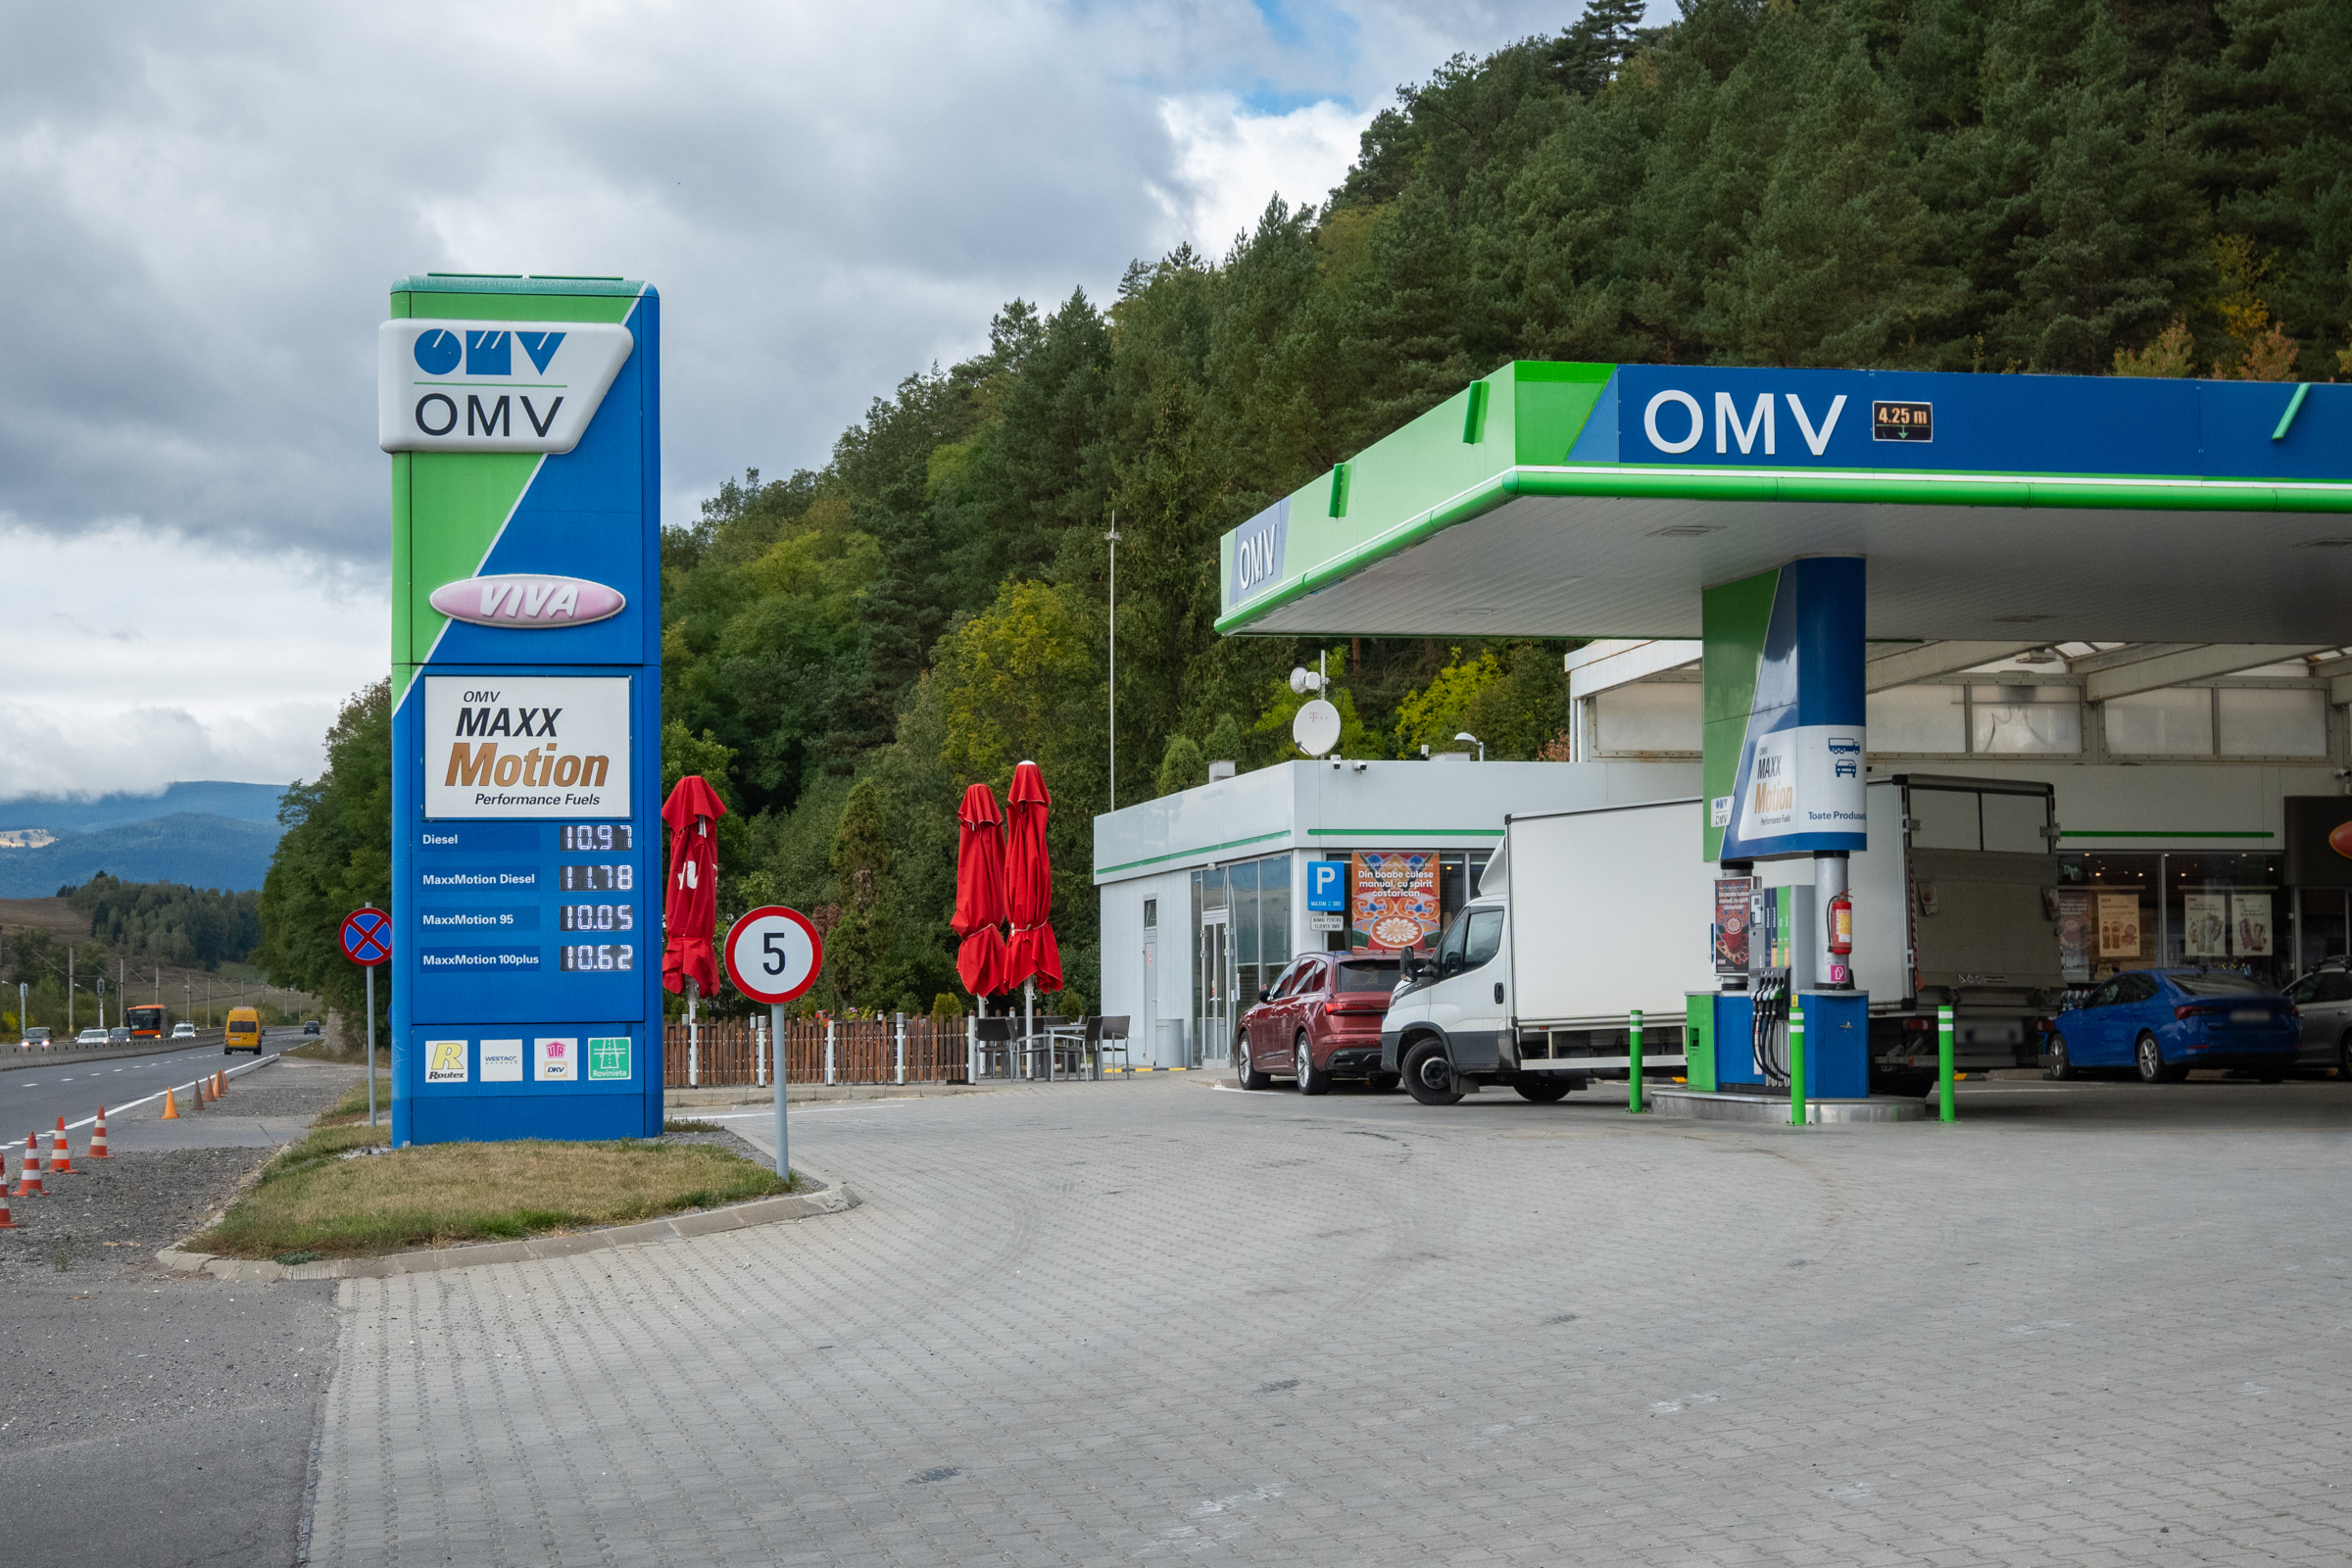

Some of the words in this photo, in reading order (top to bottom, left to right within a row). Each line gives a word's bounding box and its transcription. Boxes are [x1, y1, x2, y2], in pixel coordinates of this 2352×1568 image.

[415, 392, 564, 438] OMV
[1643, 390, 1847, 456] OMV
[1878, 407, 1910, 425] 4.25
[1913, 410, 1928, 425] m
[1240, 524, 1276, 590] OMV
[479, 582, 580, 618] VIVA
[463, 690, 500, 703] OMV
[455, 707, 563, 737] MAXX
[444, 742, 609, 787] Motion
[1757, 755, 1782, 780] MAXX
[475, 793, 561, 806] Performance
[565, 793, 600, 806] Fuels
[1754, 780, 1793, 815] Motion
[1715, 814, 1728, 825] OMV
[1761, 817, 1781, 826] Performance
[1808, 811, 1831, 820] Toate
[422, 834, 458, 845] Diesel
[566, 825, 633, 850] 10.97
[422, 874, 496, 885] MaxxMotion
[500, 873, 535, 884] Diesel
[566, 865, 633, 889] 11.78
[1317, 867, 1335, 894] P
[1359, 880, 1395, 888] manual,
[1410, 880, 1433, 889] spirit
[422, 915, 496, 925] MaxxMotion
[500, 914, 514, 925] 95
[567, 905, 633, 930] 10.05
[423, 955, 496, 965] MaxxMotion
[498, 954, 539, 965] 100plus
[567, 945, 633, 970] 10.62
[762, 932, 786, 976] 5
[431, 1043, 464, 1069] R
[429, 1071, 465, 1079] Routex
